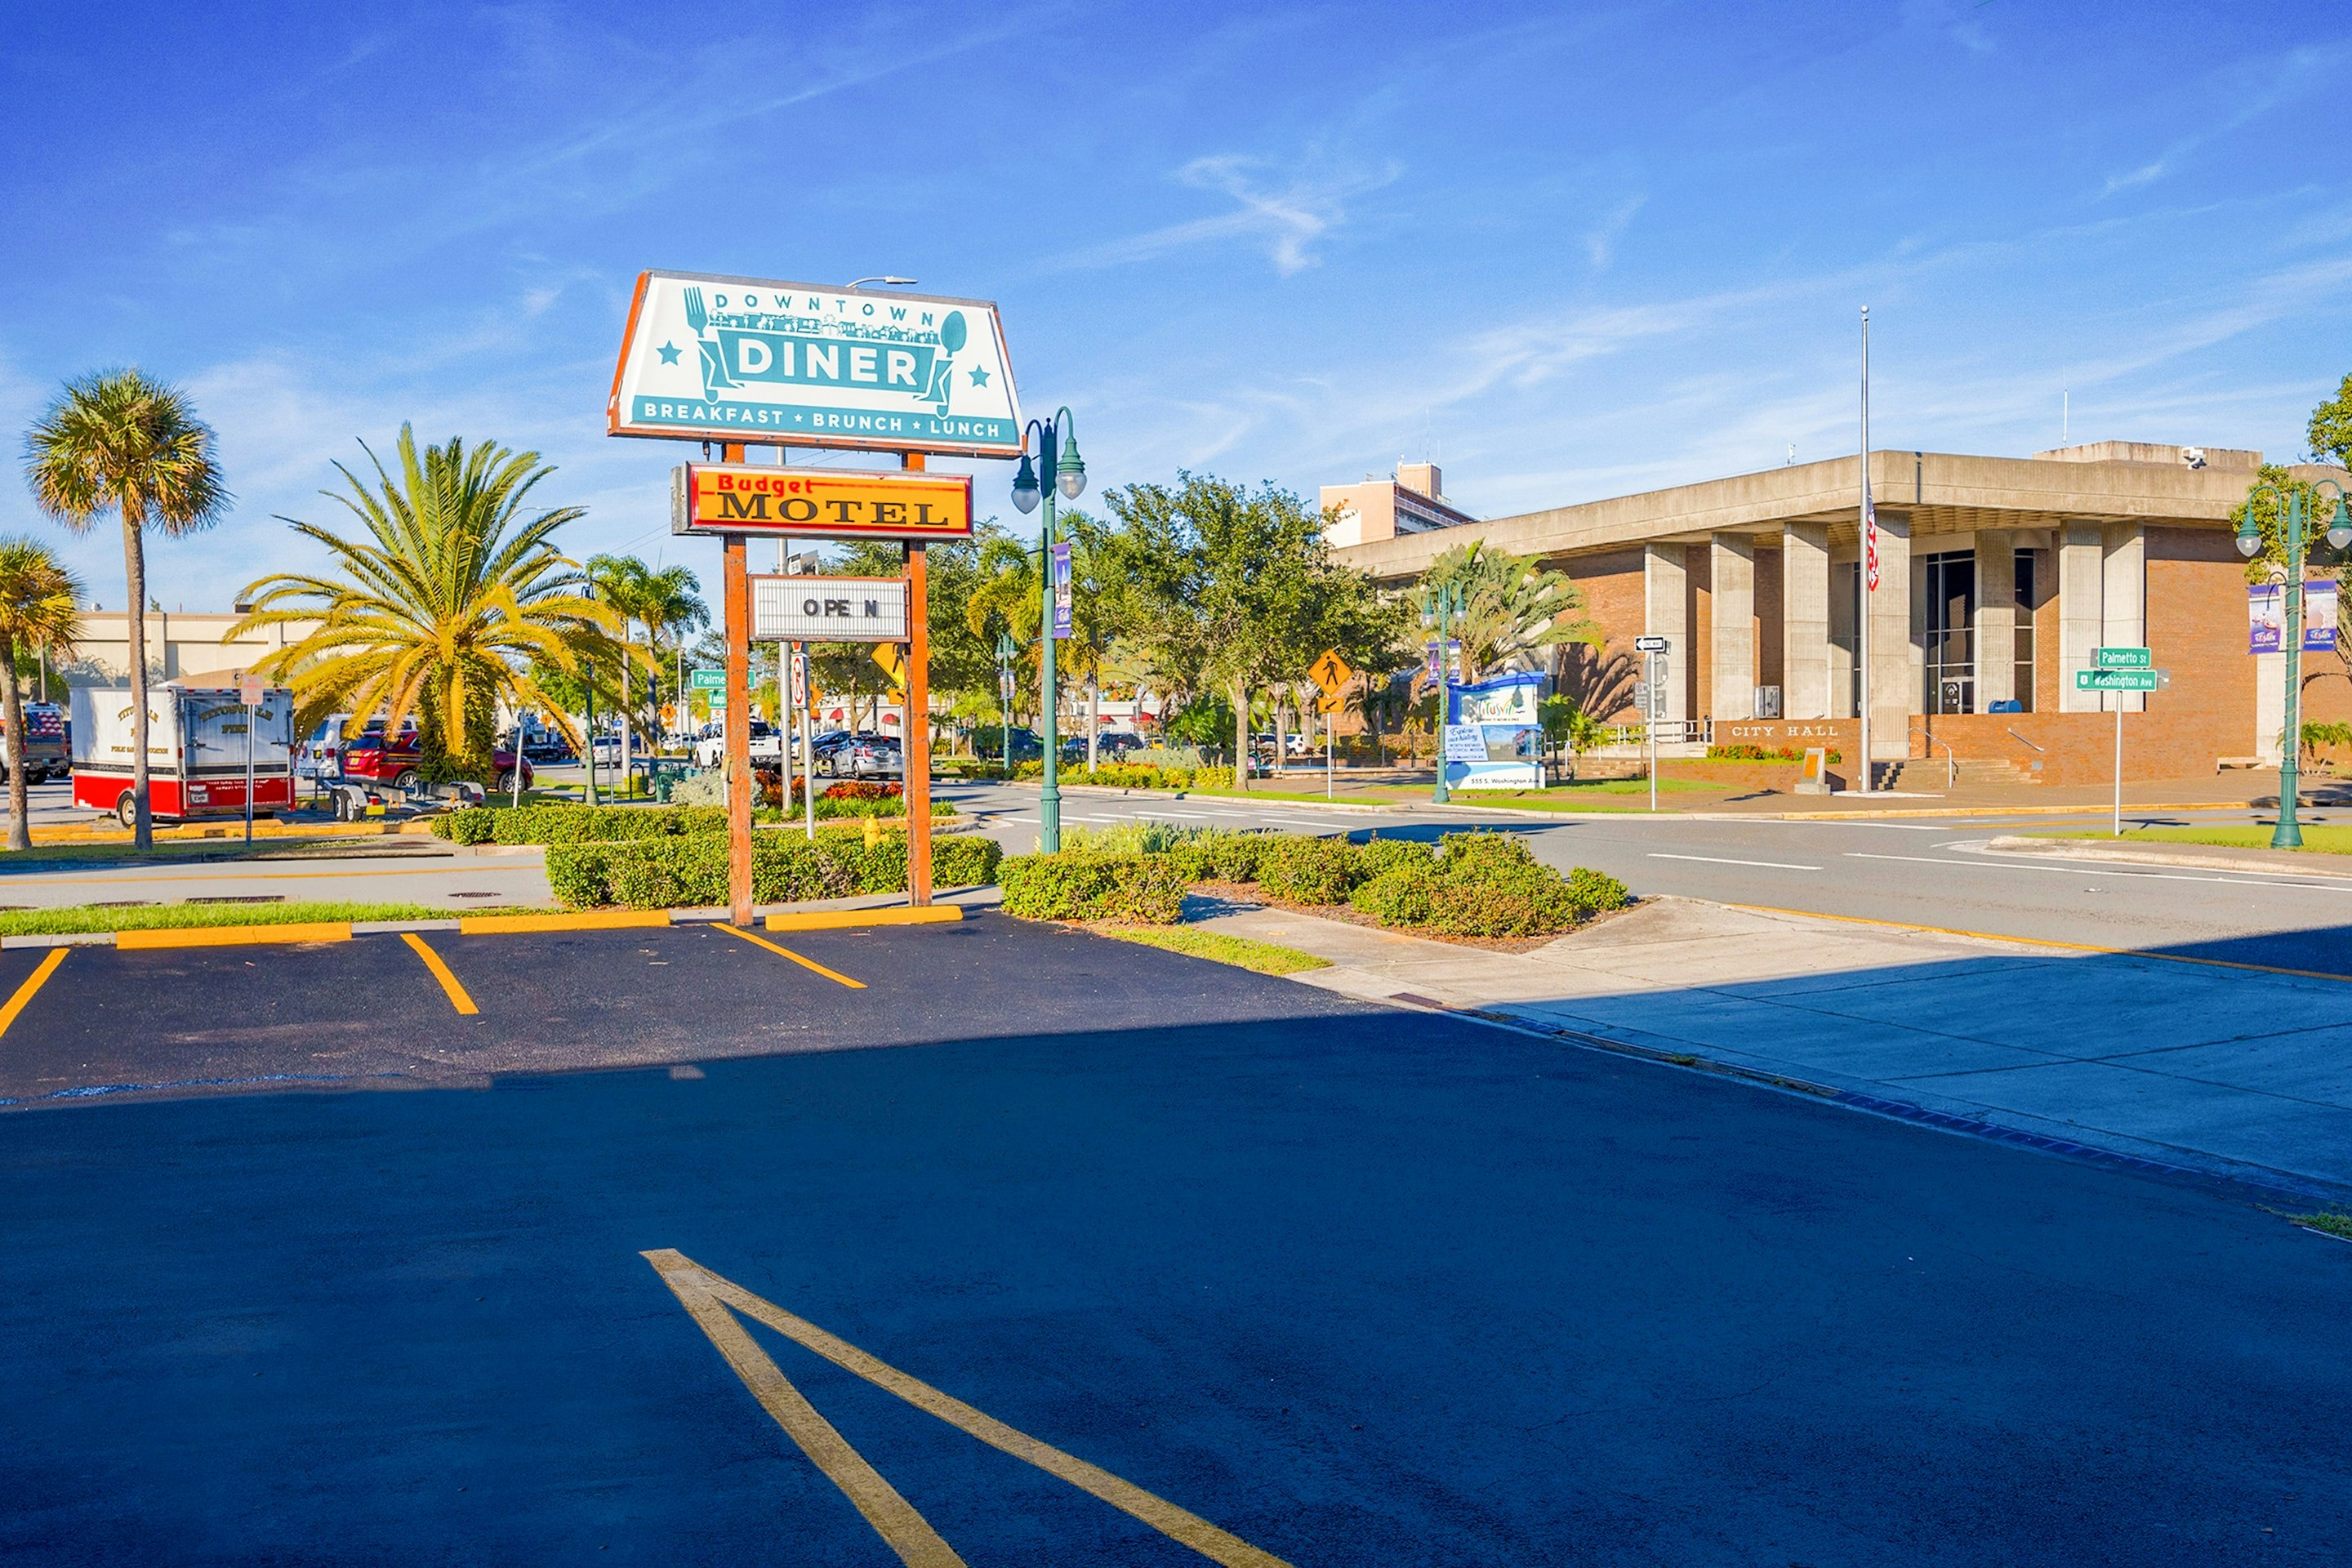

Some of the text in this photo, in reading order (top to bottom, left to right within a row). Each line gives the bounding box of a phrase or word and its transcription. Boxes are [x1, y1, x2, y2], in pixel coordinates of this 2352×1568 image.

[715, 293, 933, 327] DOWNTOWN
[737, 338, 918, 386] DINER
[644, 403, 1000, 438] BREAKFAST BRUNCH LUNCH
[718, 474, 813, 498] Budget
[717, 492, 949, 526] MOTEL
[2102, 652, 2147, 664] Palmetto St
[697, 675, 726, 685] Palme
[2094, 675, 2138, 688] Washington
[2140, 678, 2153, 687] Ave
[1450, 727, 1474, 737] Explore
[1459, 733, 1478, 742] history
[1731, 725, 1839, 737] CITY HALL
